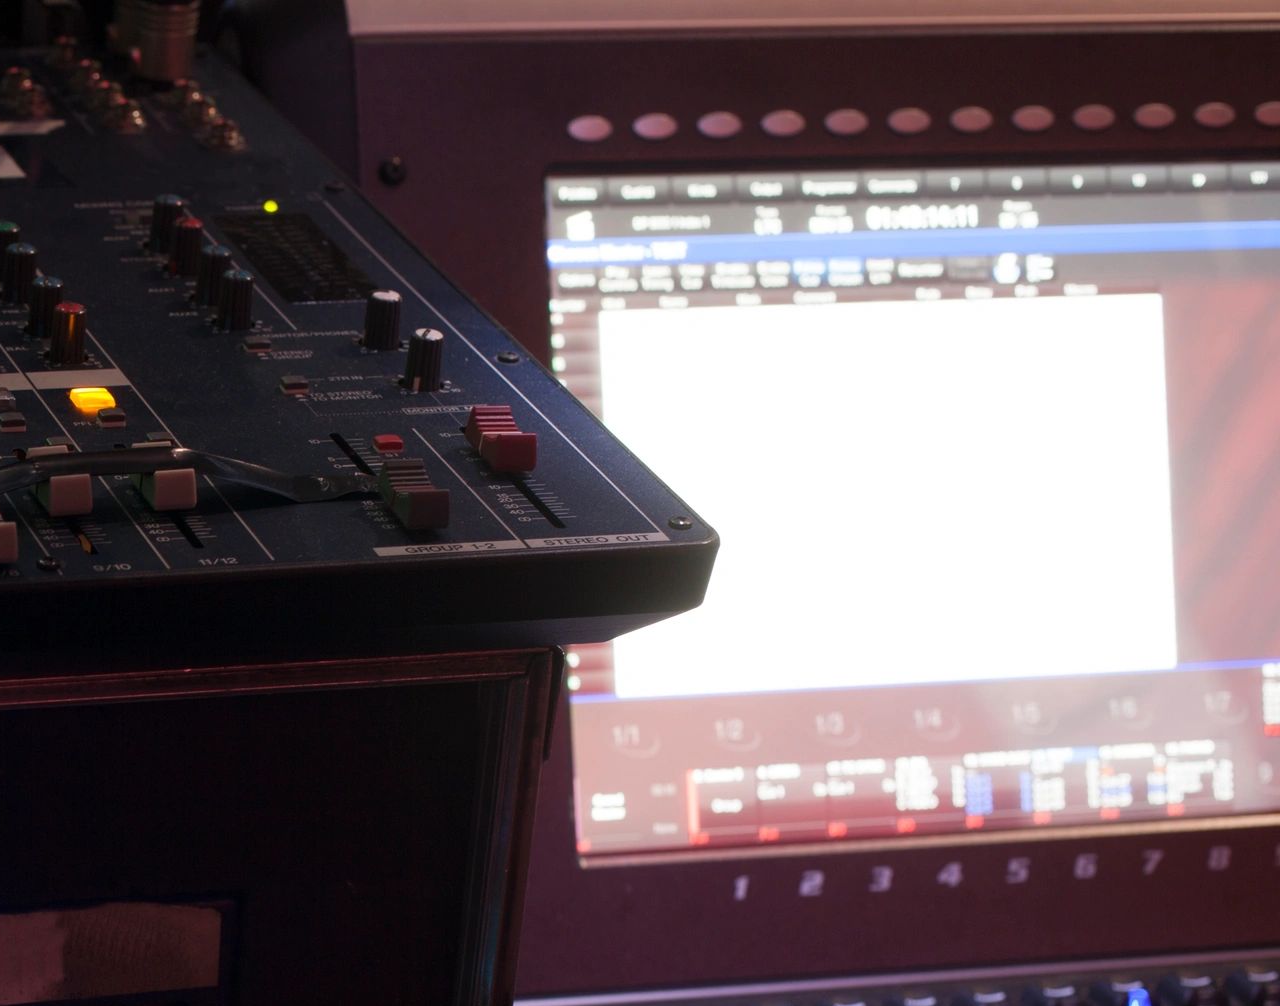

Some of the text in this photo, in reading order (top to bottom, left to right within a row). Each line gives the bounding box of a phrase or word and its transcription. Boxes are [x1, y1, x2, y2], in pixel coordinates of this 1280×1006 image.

[543, 534, 650, 546] STEREO OUT
[404, 544, 464, 554] GROUP
[198, 556, 239, 566] 11/12
[92, 562, 132, 573] 9/10
[734, 875, 750, 900] 1
[799, 870, 825, 897] 2
[869, 866, 894, 892] 3
[936, 861, 963, 888] 4
[1006, 857, 1031, 884] 5
[1073, 853, 1098, 879] 6
[1141, 849, 1164, 875] 7
